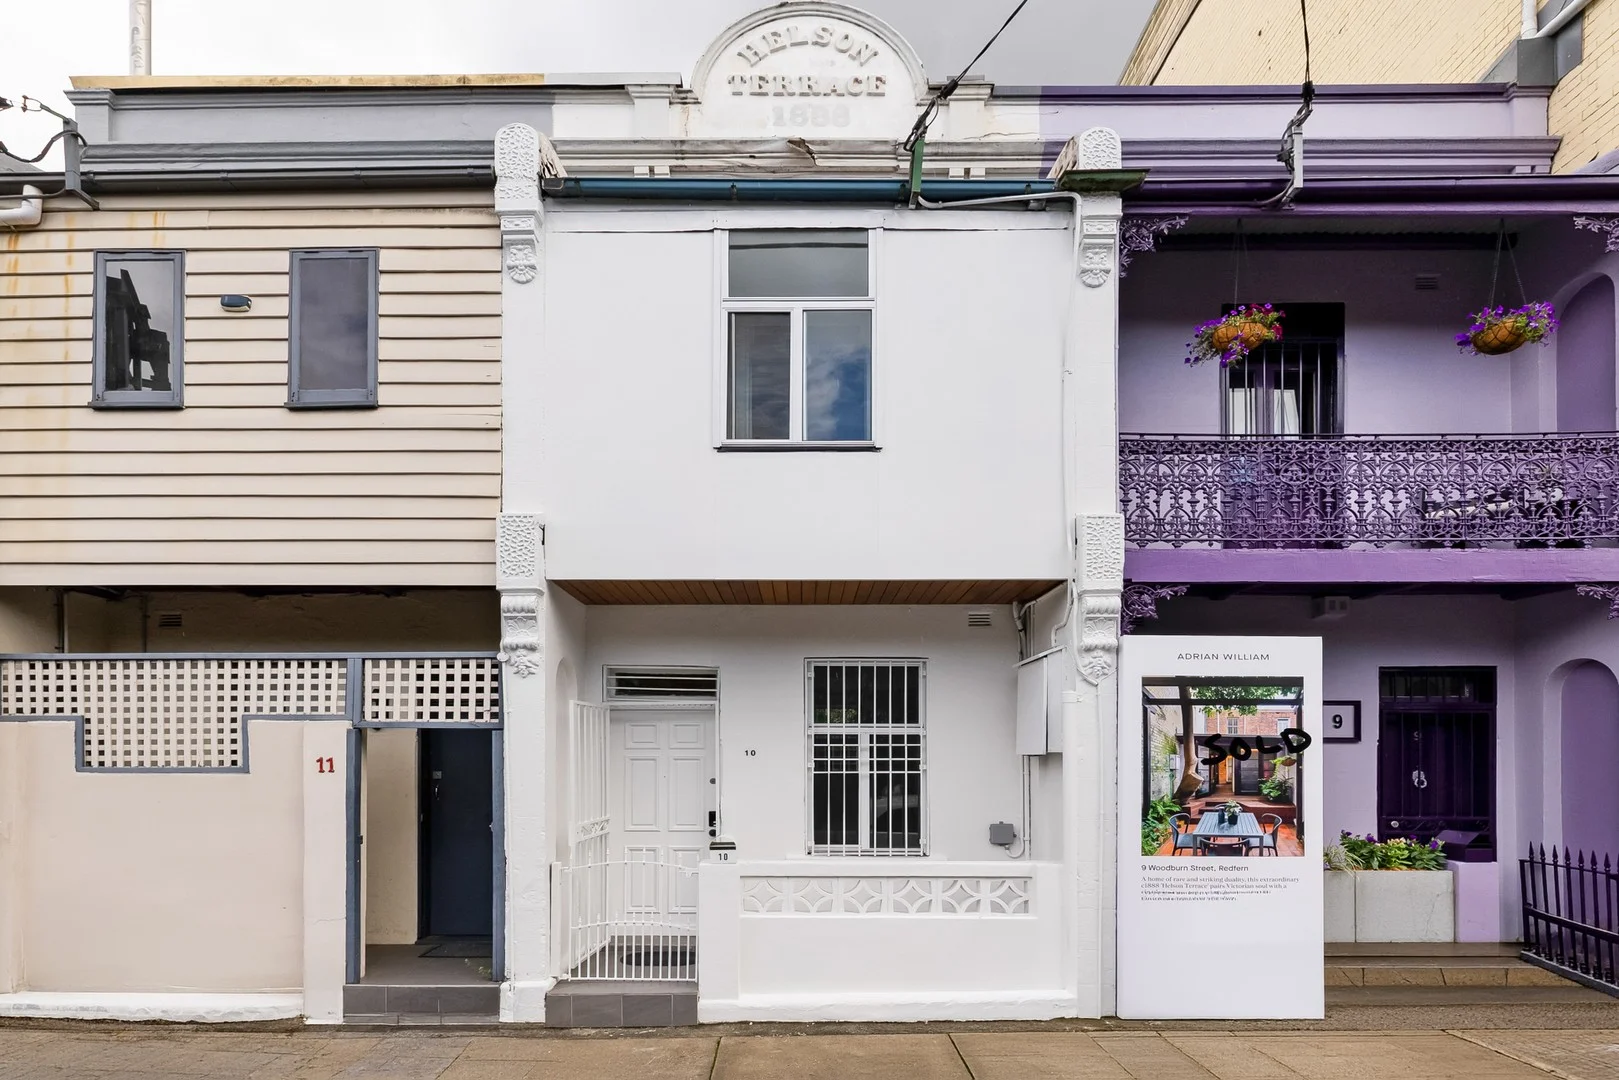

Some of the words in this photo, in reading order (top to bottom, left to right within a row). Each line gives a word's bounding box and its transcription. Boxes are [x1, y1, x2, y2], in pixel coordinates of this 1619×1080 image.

[737, 26, 879, 67] HELSON
[728, 74, 886, 97] TERRACE
[1223, 653, 1270, 661] WILLIAM
[1332, 714, 1343, 729] 9
[1200, 727, 1312, 766] SOLD
[315, 756, 335, 773] 11
[718, 852, 728, 860] 10
[1190, 864, 1217, 872] Street,
[1260, 876, 1299, 884] extraordinary
